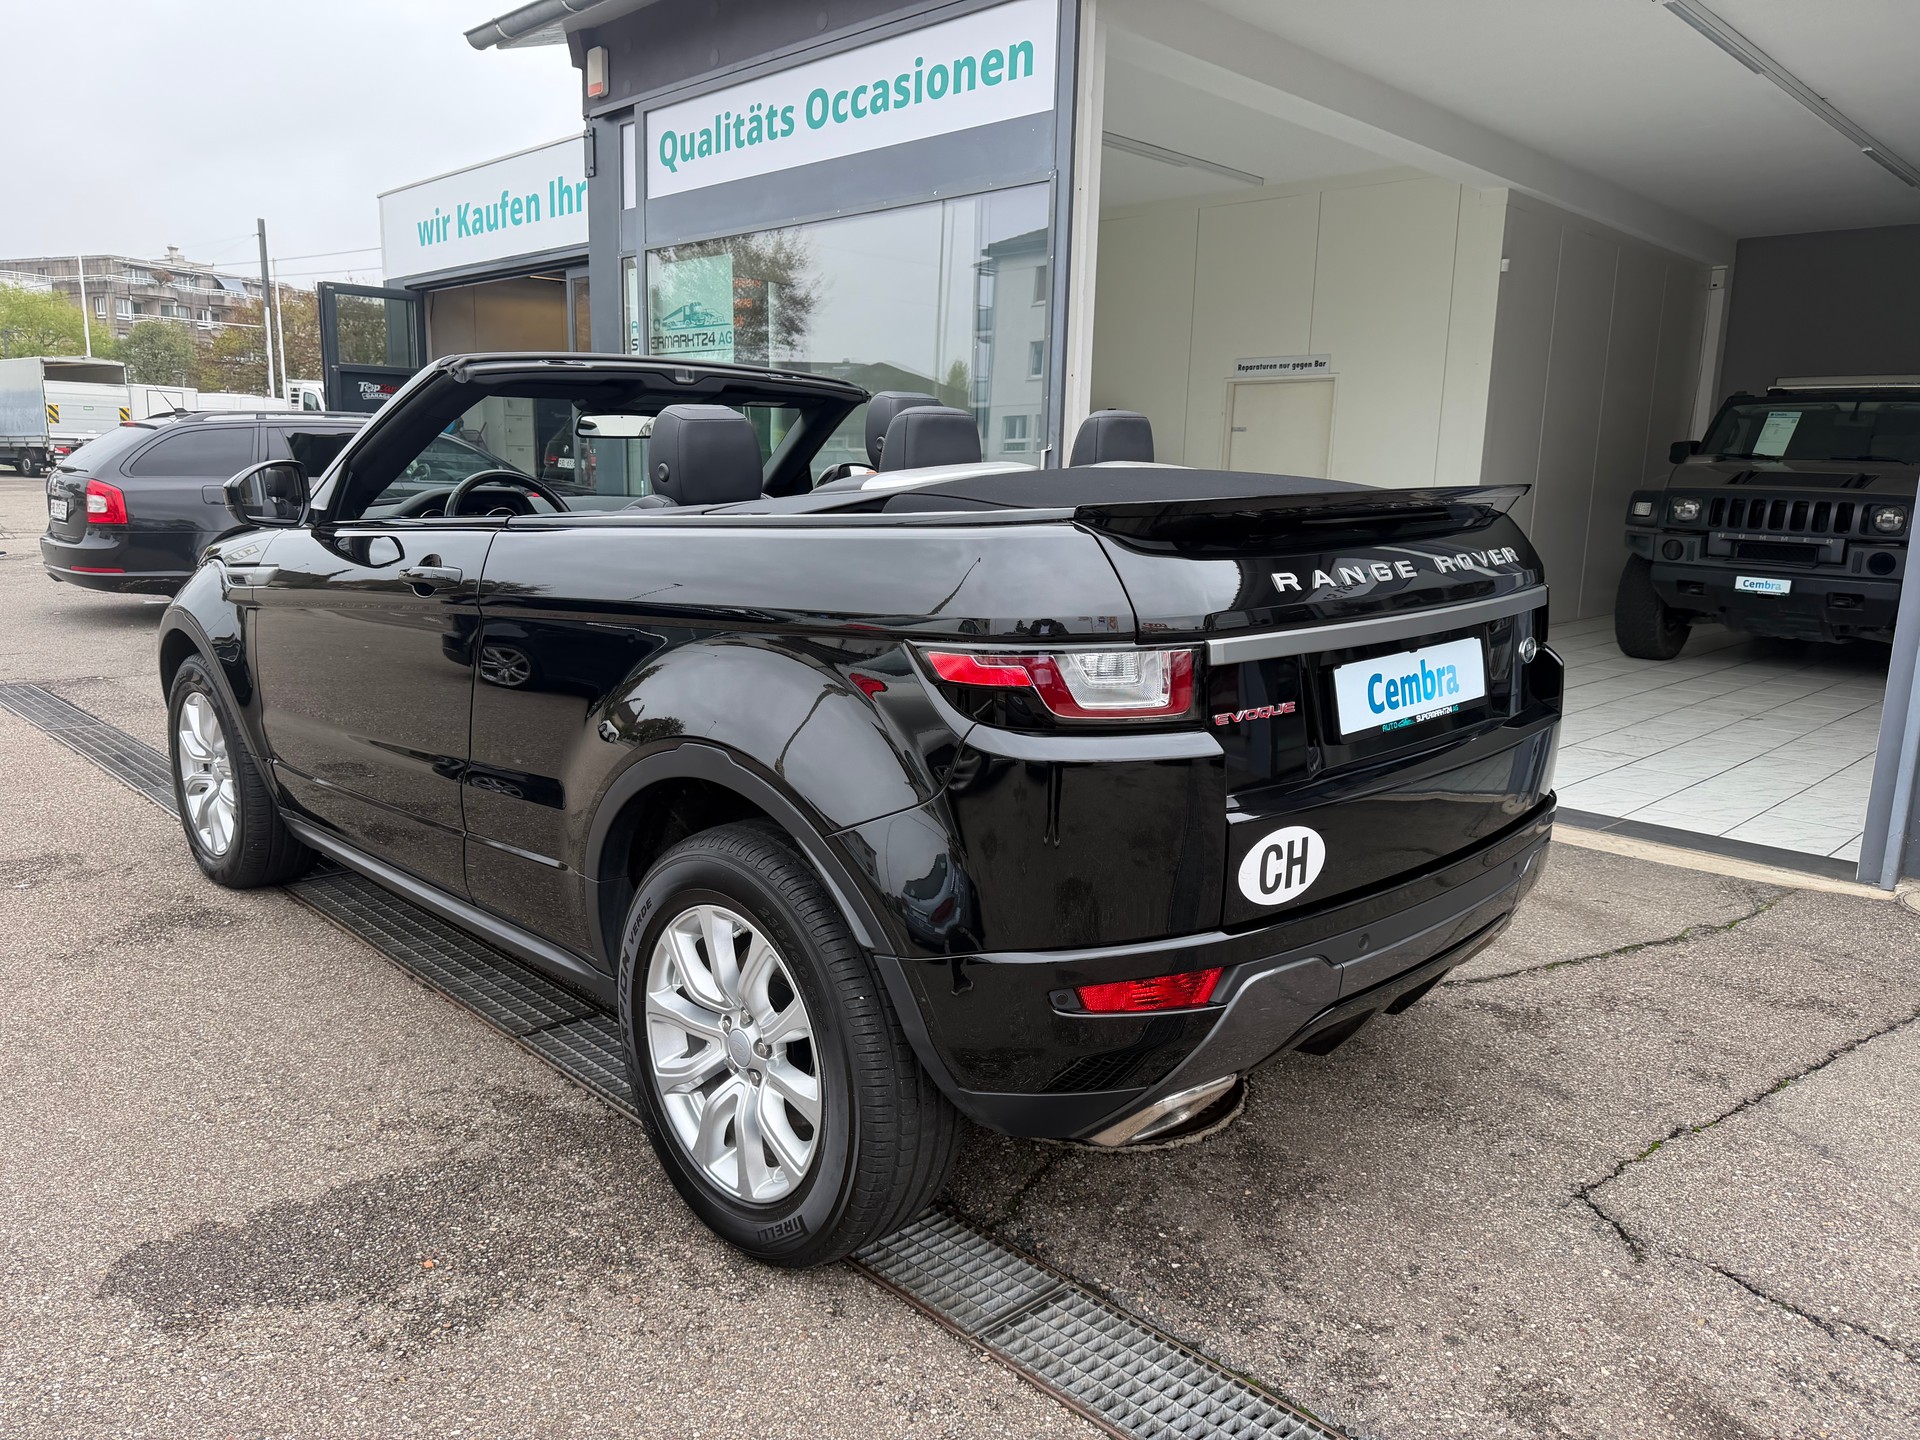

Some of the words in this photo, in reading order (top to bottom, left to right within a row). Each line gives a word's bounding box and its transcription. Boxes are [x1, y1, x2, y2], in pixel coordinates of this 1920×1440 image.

[658, 104, 796, 173] Qualitäts
[805, 39, 1034, 131] Occasionen
[417, 207, 450, 247] wir
[455, 191, 540, 238] Kaufen
[549, 177, 588, 221] Ihr
[718, 331, 733, 345] AG
[1238, 364, 1277, 372] Reparaturen
[1292, 362, 1312, 370] gegen
[1718, 532, 1834, 544] HUMMER
[1271, 560, 1417, 592] RANGE
[1434, 546, 1519, 574] ROVER
[1742, 579, 1782, 591] Cembra
[1367, 659, 1459, 714] Cembra
[1213, 702, 1296, 726] EVOQUE
[1382, 721, 1398, 732] AUTO
[1259, 836, 1309, 895] CH
[628, 897, 653, 944] VERDE
